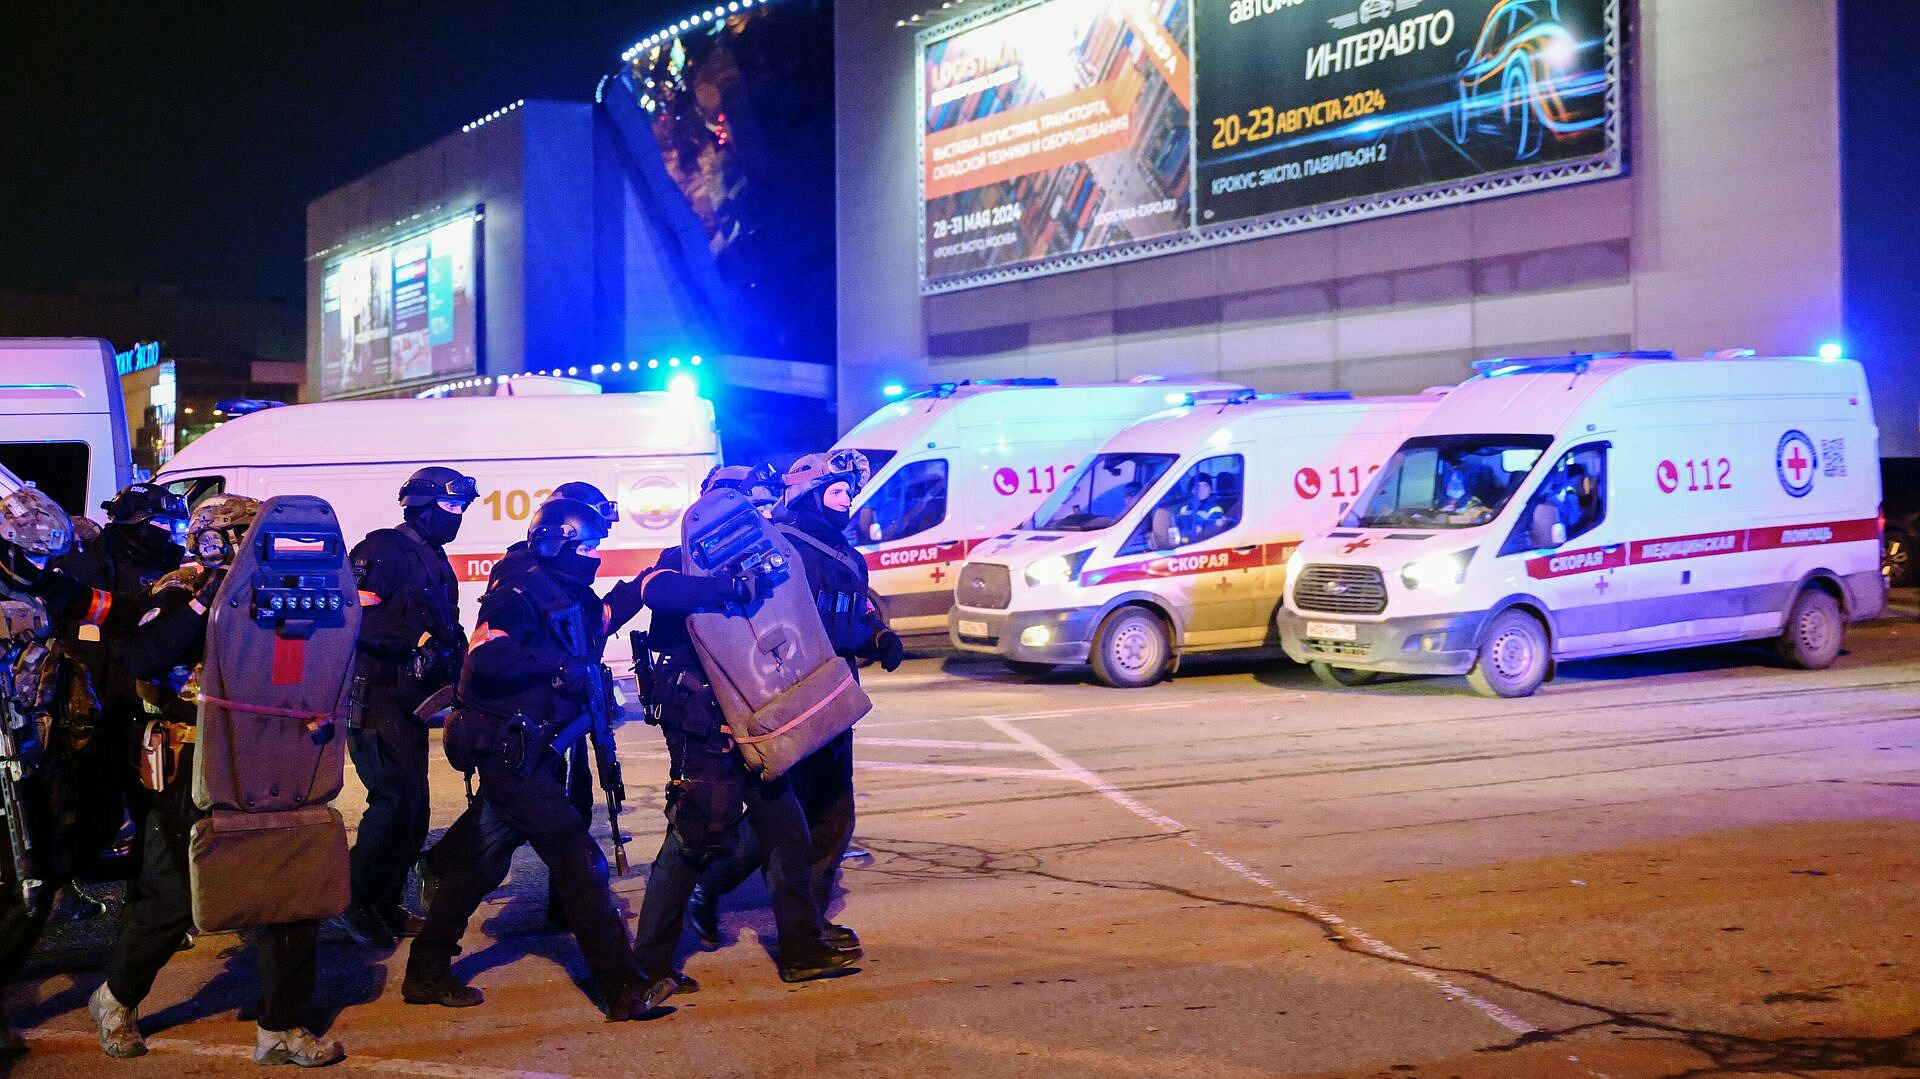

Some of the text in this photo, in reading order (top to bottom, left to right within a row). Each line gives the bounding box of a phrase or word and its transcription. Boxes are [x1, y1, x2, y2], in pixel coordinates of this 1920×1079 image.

[1229, 0, 1304, 24] авто
[1305, 8, 1455, 80] ИНТЕРАВТО
[1211, 88, 1386, 149] 20-23 АВГУСТА 2024
[1211, 171, 1257, 195] КРОКУС
[1303, 146, 1377, 176] ПАВИЛЬОН
[1378, 143, 1388, 162] 2
[932, 201, 1022, 239] 28-31 МАЯ 2024
[1027, 464, 1076, 494] 11
[1329, 464, 1380, 497] 11
[1686, 457, 1732, 491] 112
[880, 547, 938, 566] СКОРАЯ
[1167, 552, 1230, 573] СКОРАЯ
[1548, 550, 1604, 573] СКОРАЯ
[1641, 535, 1736, 559] МЕДИЦИНСКАЯ
